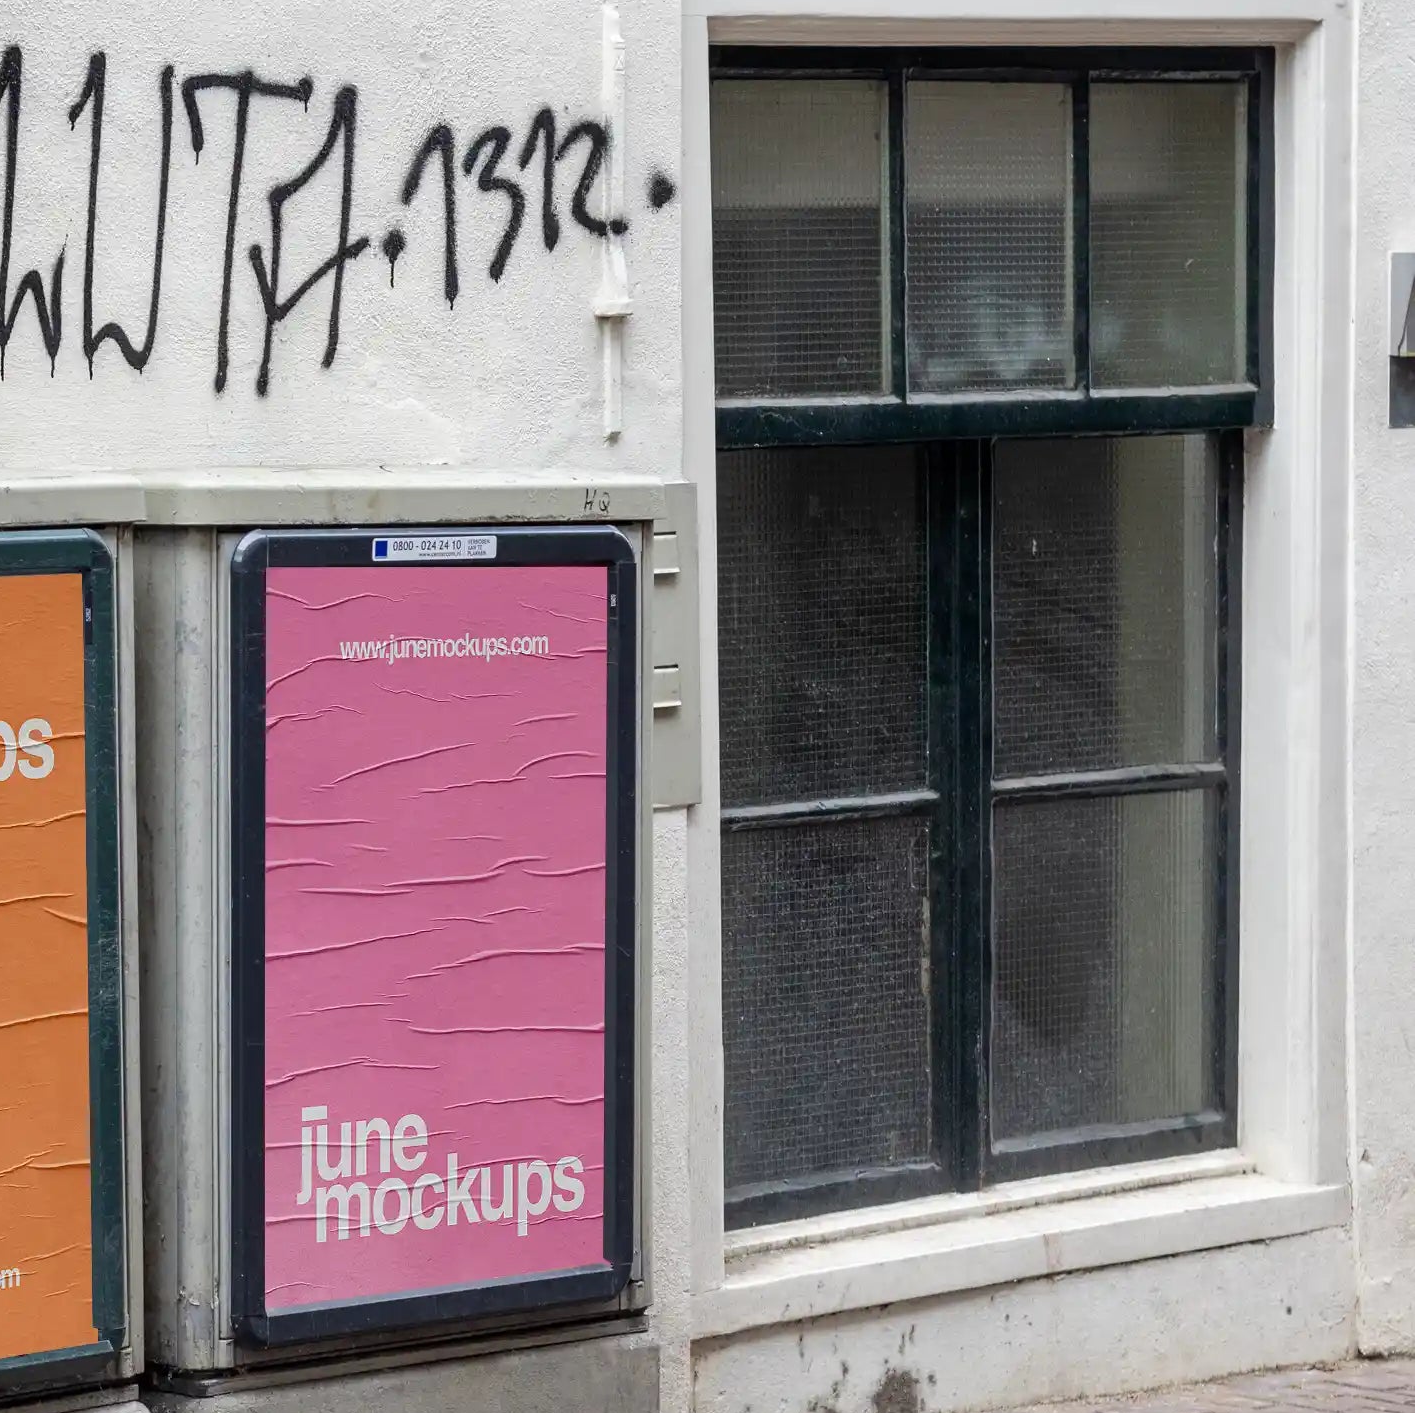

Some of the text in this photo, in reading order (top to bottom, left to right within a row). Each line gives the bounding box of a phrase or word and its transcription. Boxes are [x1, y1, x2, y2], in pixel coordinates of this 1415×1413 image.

[392, 541, 413, 551] 0800
[421, 540, 436, 551] 024
[439, 540, 449, 550] 24
[452, 539, 462, 549] 10
[338, 632, 549, 665] www.junemockups.com
[296, 1105, 429, 1206] june
[315, 1152, 585, 1244] mockups
